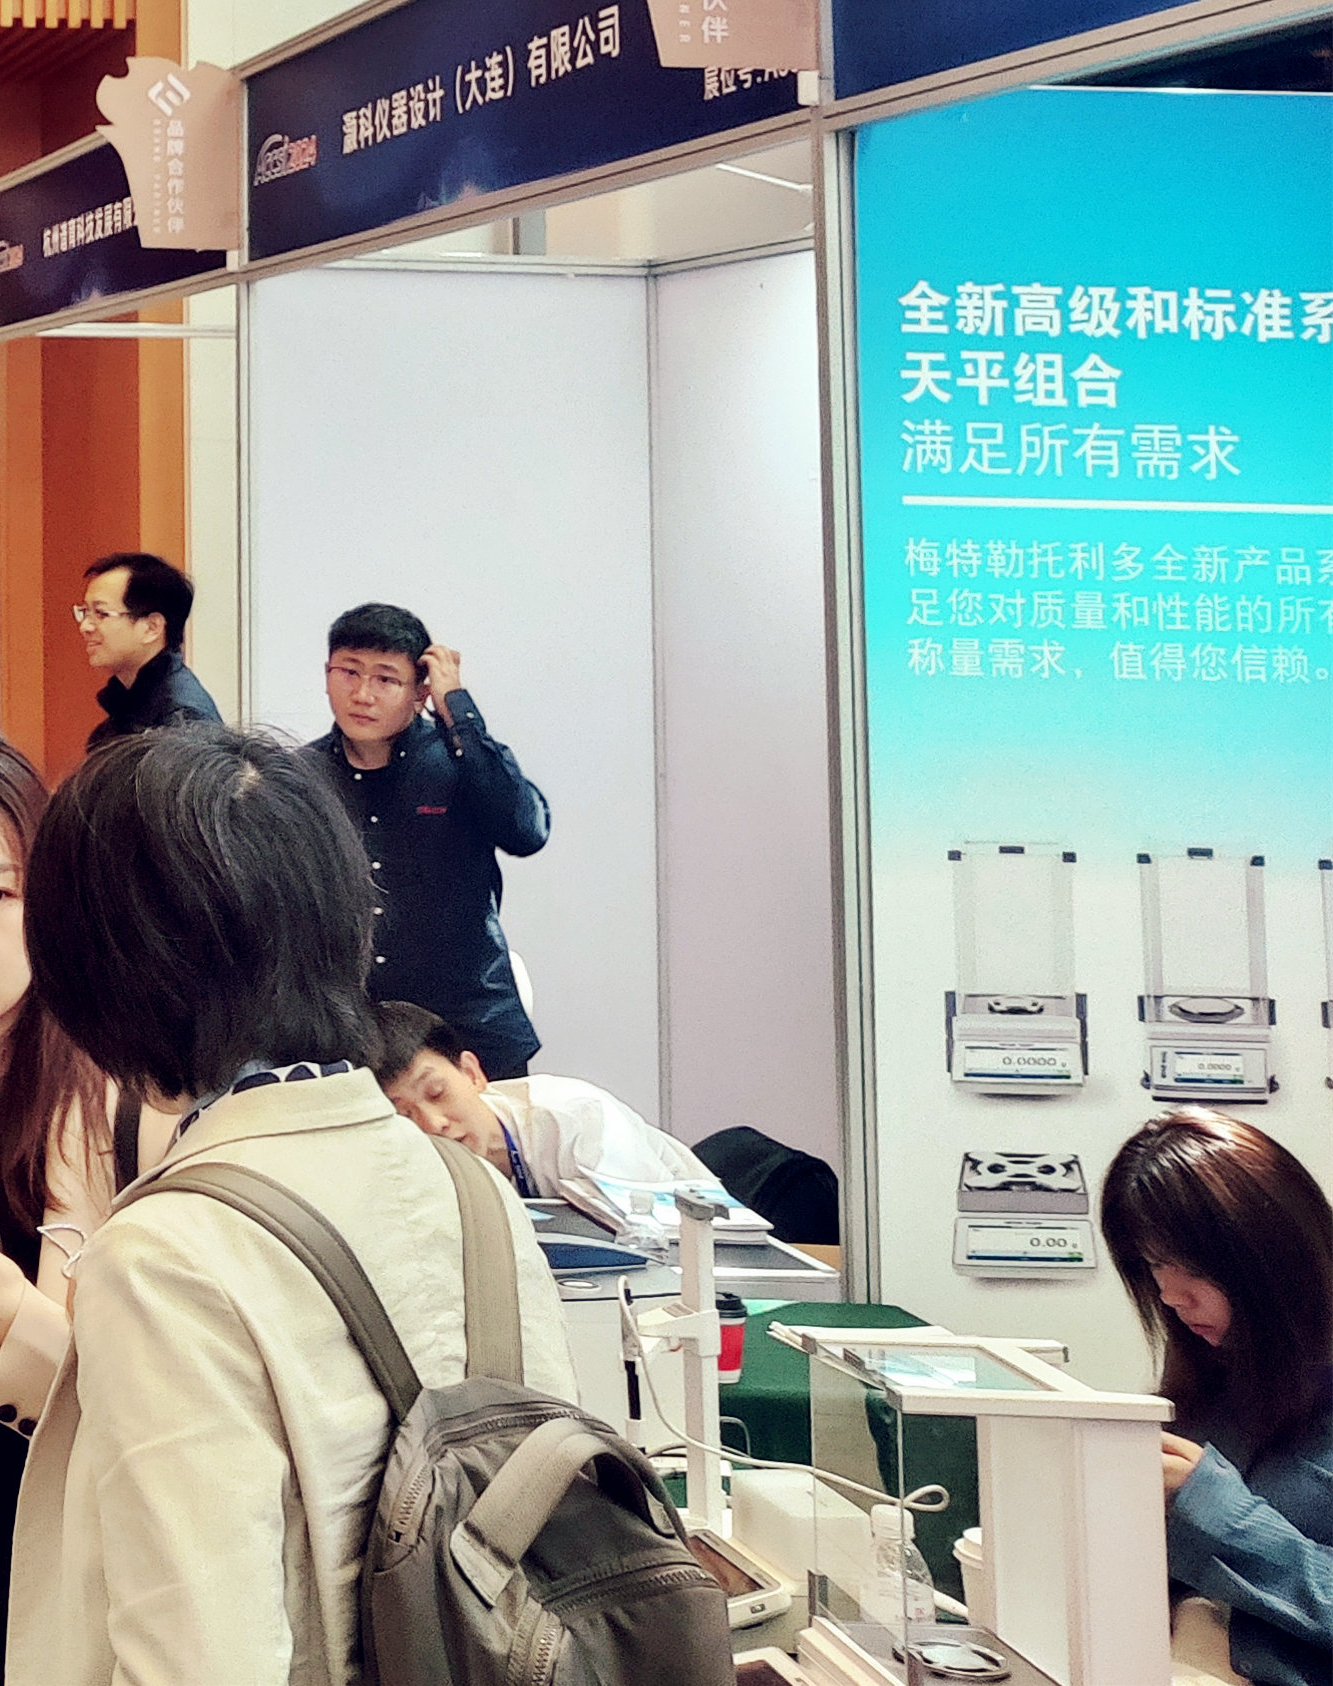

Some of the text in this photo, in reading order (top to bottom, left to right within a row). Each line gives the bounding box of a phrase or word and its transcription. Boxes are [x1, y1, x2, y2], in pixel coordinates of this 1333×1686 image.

[899, 350, 1123, 409] 天平组合
[900, 417, 1242, 481] 满足所有需求
[1029, 1237, 1068, 1248] 0.00
